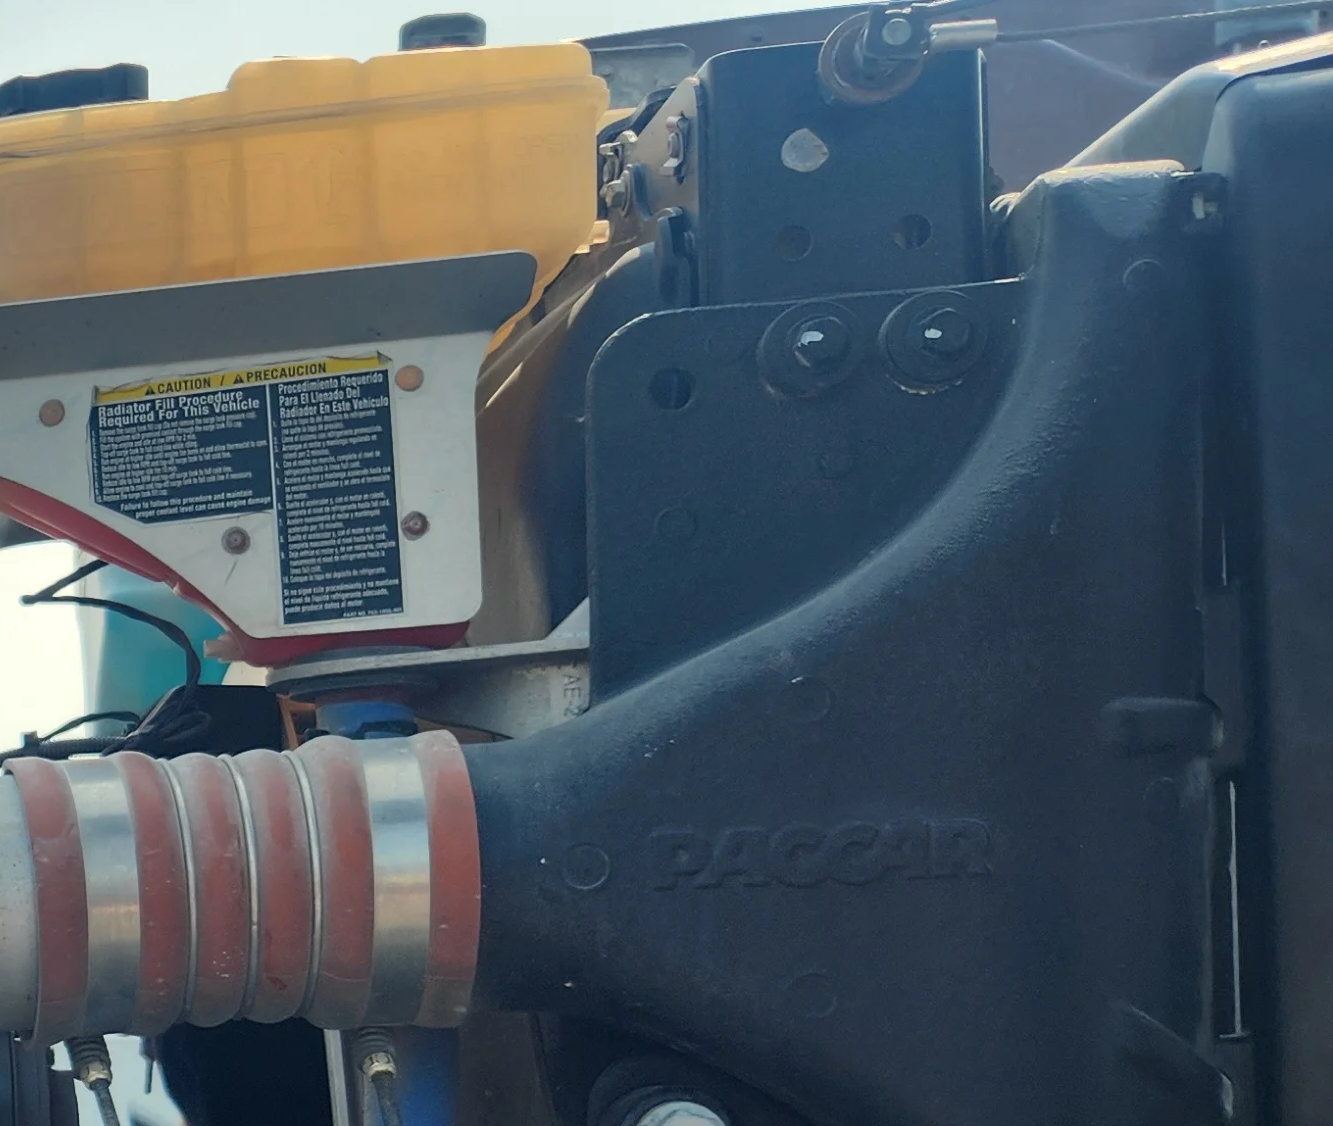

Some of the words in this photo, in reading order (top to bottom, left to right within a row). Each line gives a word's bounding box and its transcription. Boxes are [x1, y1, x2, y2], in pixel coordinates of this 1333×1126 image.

[158, 377, 211, 394] CAUTION
[247, 362, 327, 382] PRECAUCION
[278, 378, 338, 394] Procedimiento
[341, 373, 383, 387] Requerido
[98, 402, 150, 418] Radiator
[155, 397, 174, 411] Fill
[179, 391, 243, 407] Procedure
[279, 395, 298, 406] Para
[301, 393, 308, 403] El
[312, 388, 345, 402] Llenado
[346, 387, 360, 398] Del
[280, 405, 317, 418] Radiador
[320, 403, 330, 414] En
[333, 401, 351, 413] Este
[99, 410, 154, 430] Required
[159, 408, 178, 420] For
[183, 404, 209, 418] This
[214, 398, 260, 414] Vehicle
[647, 818, 993, 892] PACCAR
